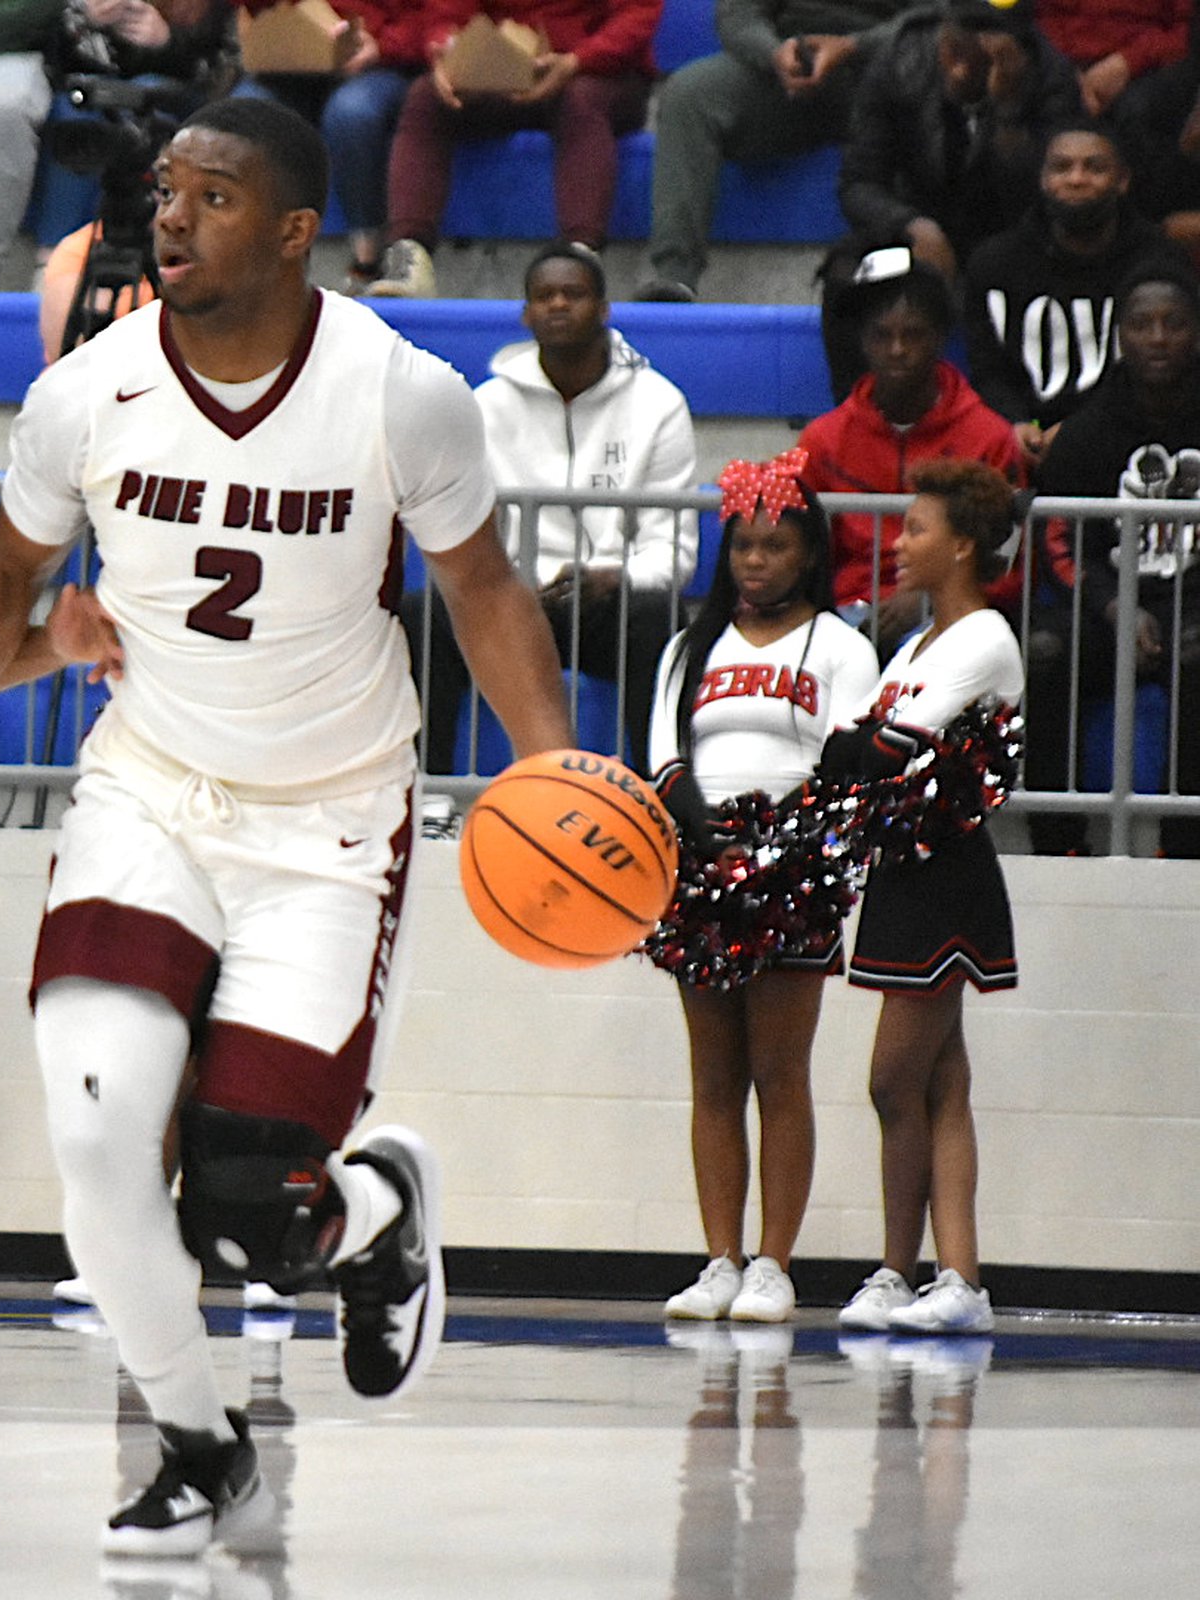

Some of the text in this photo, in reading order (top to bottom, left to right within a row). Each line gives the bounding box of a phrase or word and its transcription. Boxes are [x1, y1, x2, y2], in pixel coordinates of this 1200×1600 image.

[115, 470, 354, 535] PINE BLUFF
[185, 545, 264, 642] 2
[555, 809, 637, 871] EVO
